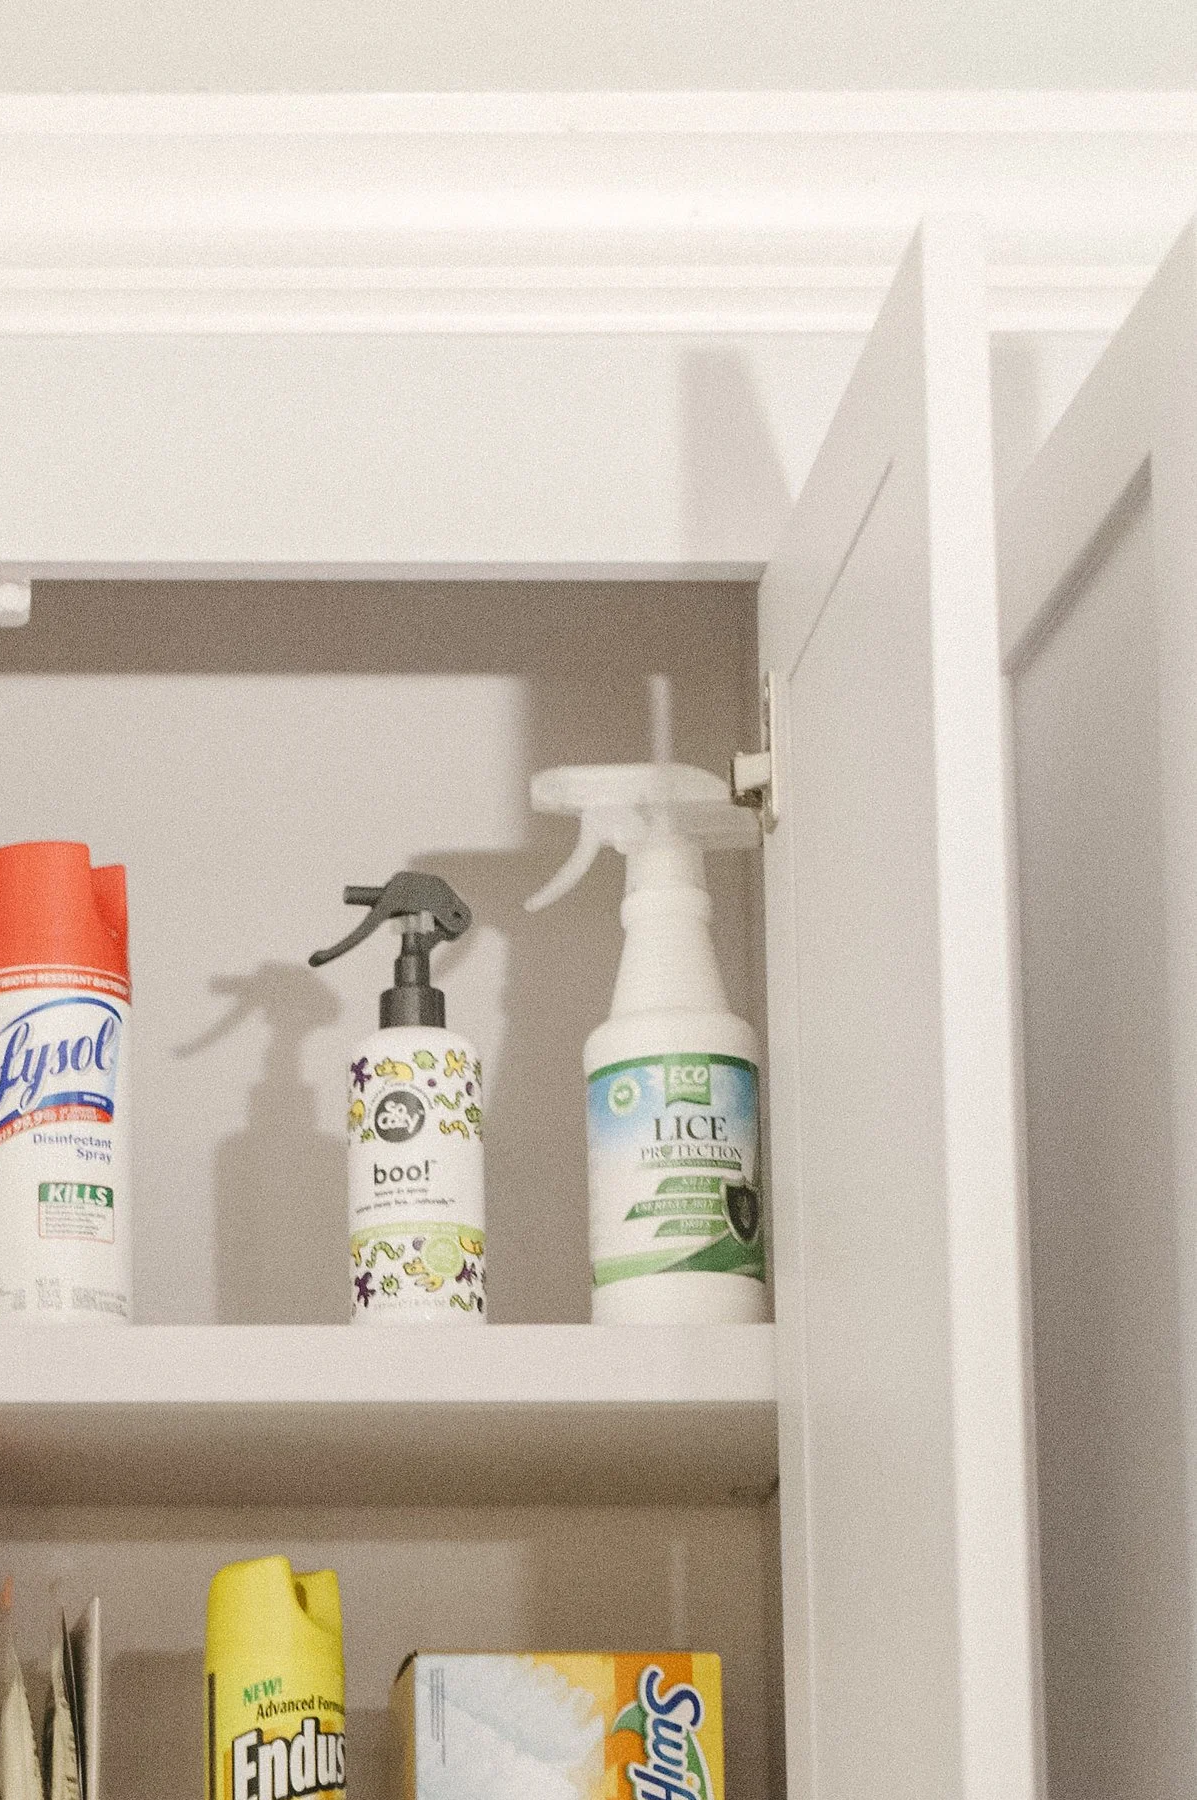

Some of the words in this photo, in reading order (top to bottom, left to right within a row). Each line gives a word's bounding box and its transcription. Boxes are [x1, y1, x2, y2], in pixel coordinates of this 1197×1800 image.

[669, 1066, 709, 1085] ECO
[32, 1132, 113, 1150] Disinfectant
[654, 1115, 729, 1142] LICE
[75, 1147, 113, 1166] Spray
[373, 1159, 430, 1186] boo!
[46, 1184, 110, 1207] KILLS
[242, 1677, 283, 1706] NEW!
[256, 1694, 316, 1722] Advanced
